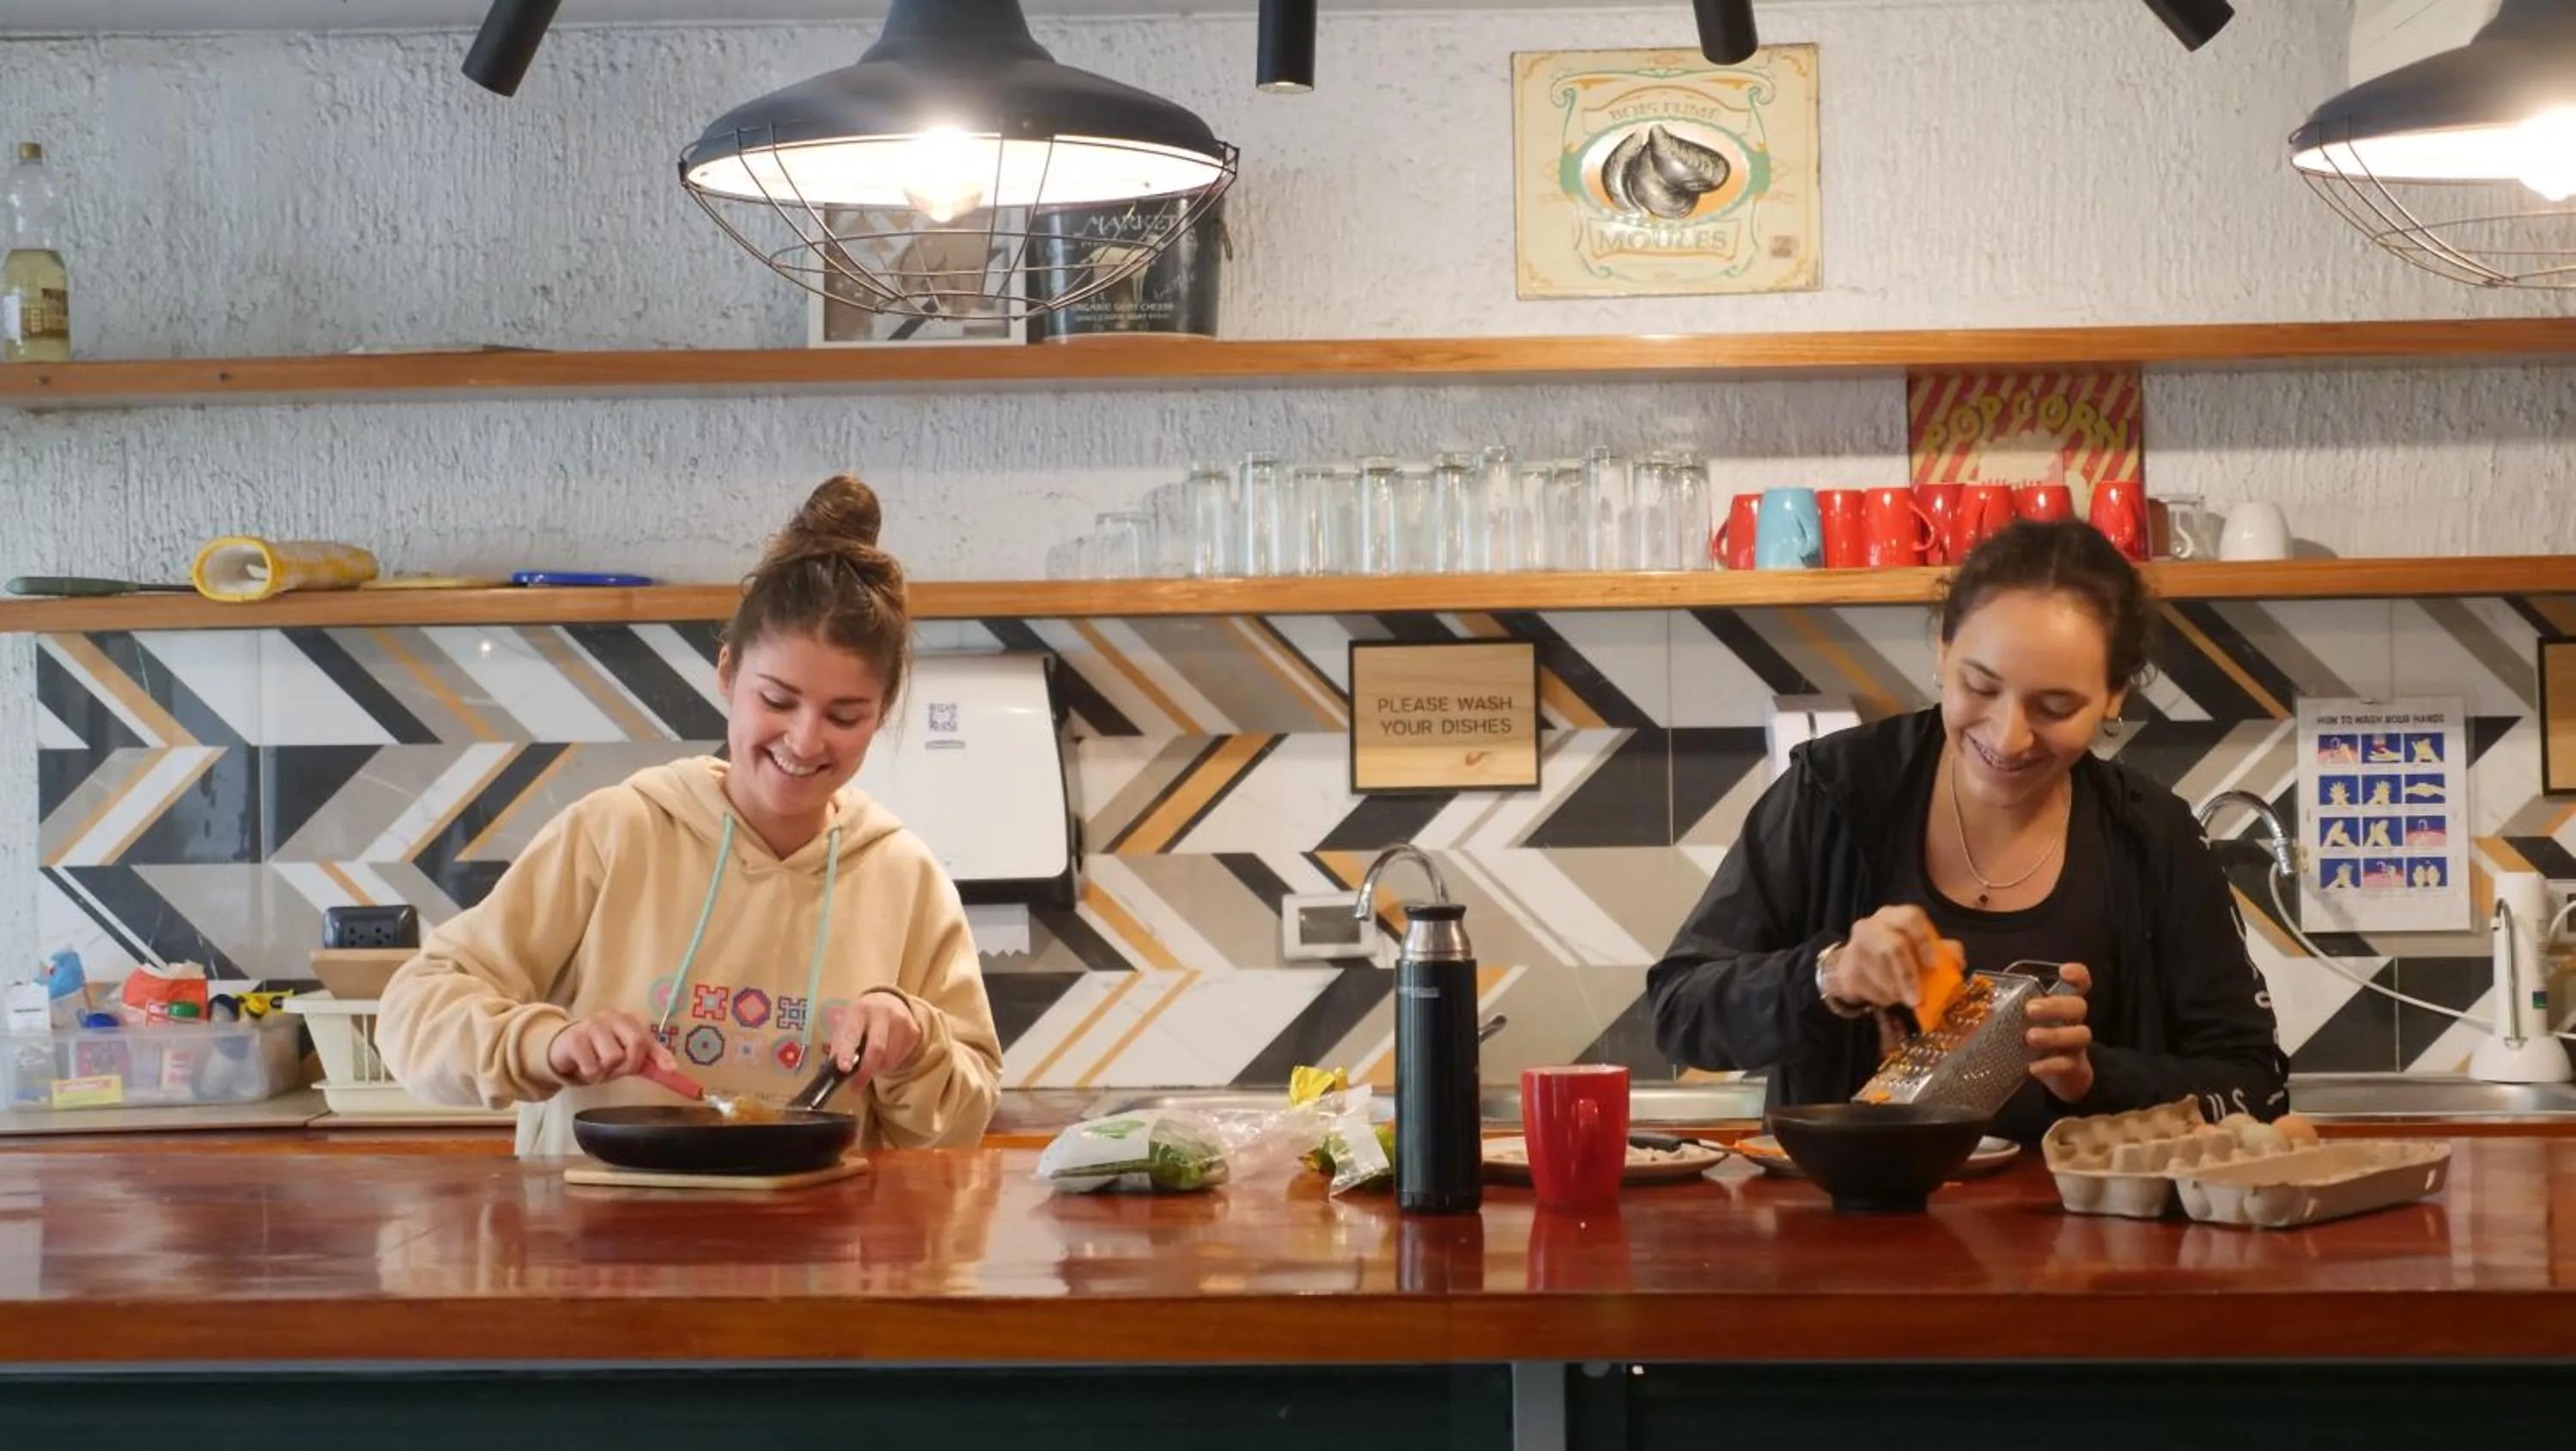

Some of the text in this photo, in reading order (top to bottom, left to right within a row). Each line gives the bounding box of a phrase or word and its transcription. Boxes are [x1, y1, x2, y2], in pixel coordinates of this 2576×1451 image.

[1598, 230, 1728, 250] MOULES
[1377, 695, 1512, 713] PLEASE WASH
[1381, 718, 1512, 736] YOUR DISHES
